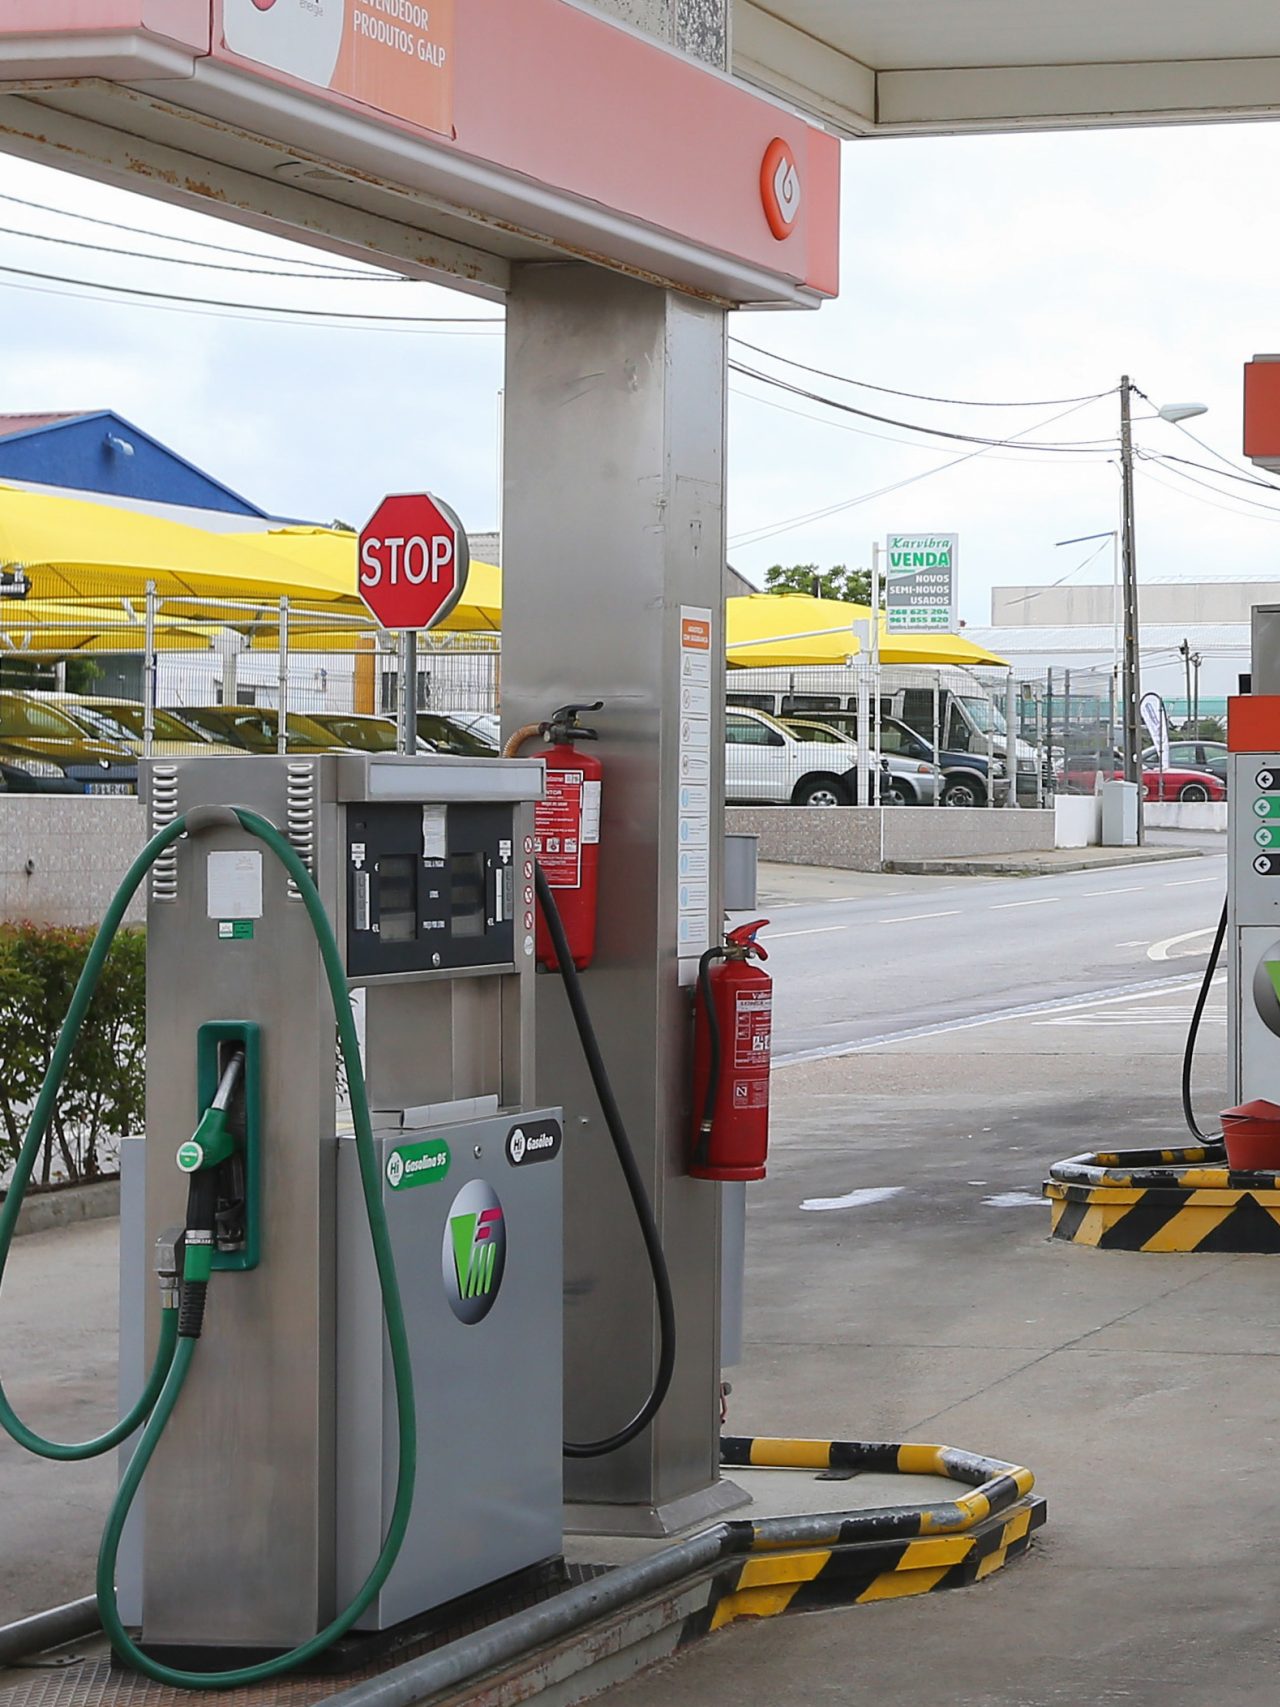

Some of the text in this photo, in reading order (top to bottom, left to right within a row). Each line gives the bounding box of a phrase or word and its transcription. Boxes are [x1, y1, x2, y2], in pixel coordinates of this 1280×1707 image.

[353, 10, 446, 68] PRODUTOS GALP
[890, 537, 950, 549] Karvibra
[361, 535, 453, 588] STOP
[890, 551, 950, 567] VENDA
[915, 575, 950, 583] NOVOS
[889, 585, 950, 594] SEMI-NOVOS
[910, 596, 950, 605] USADOS
[513, 1132, 554, 1152] Hi Gasóleo
[389, 1152, 447, 1175] Hi Gasolina 95
